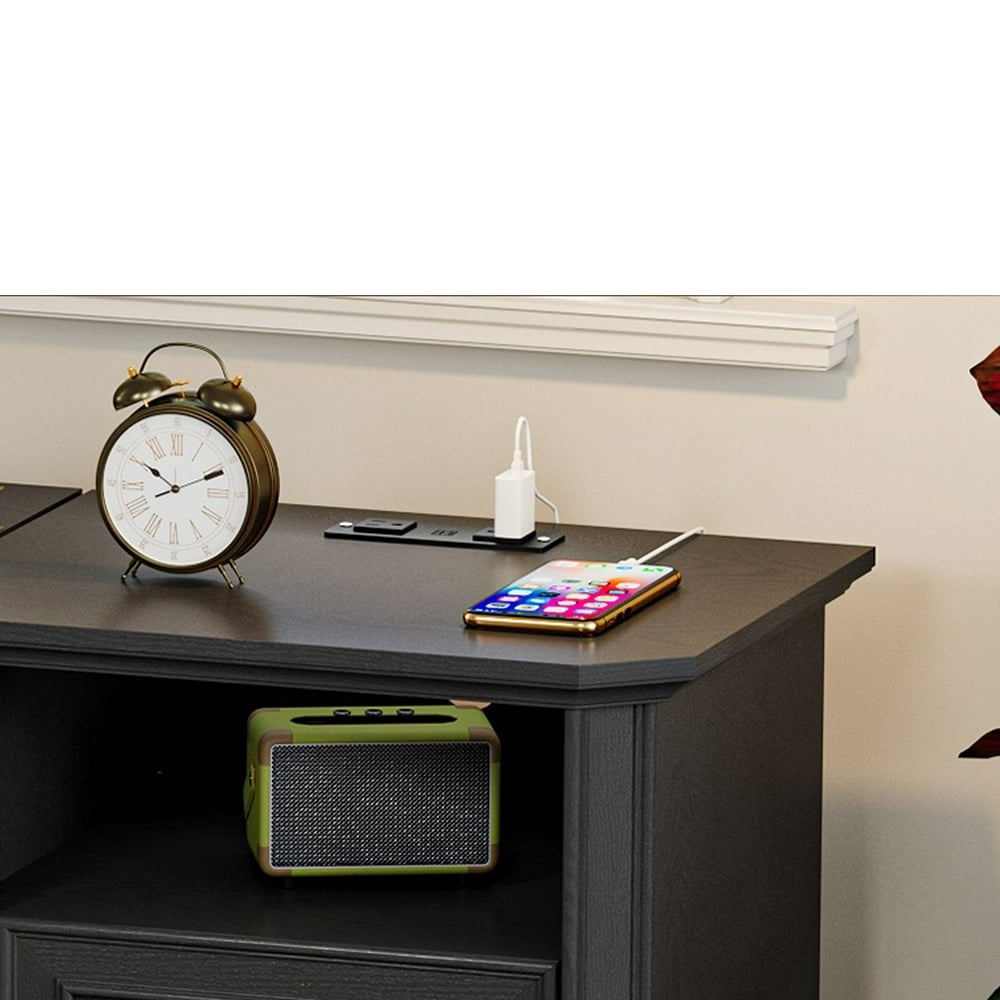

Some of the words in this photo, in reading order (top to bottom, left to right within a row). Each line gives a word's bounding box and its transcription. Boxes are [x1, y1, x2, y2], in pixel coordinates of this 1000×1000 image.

[145, 435, 167, 462] XI
[170, 433, 184, 457] XII
[121, 480, 144, 491] IX
[207, 487, 230, 499] III
[125, 494, 151, 520] VIII
[143, 512, 162, 539] VII
[168, 521, 180, 545] VI
[189, 519, 203, 541] V
